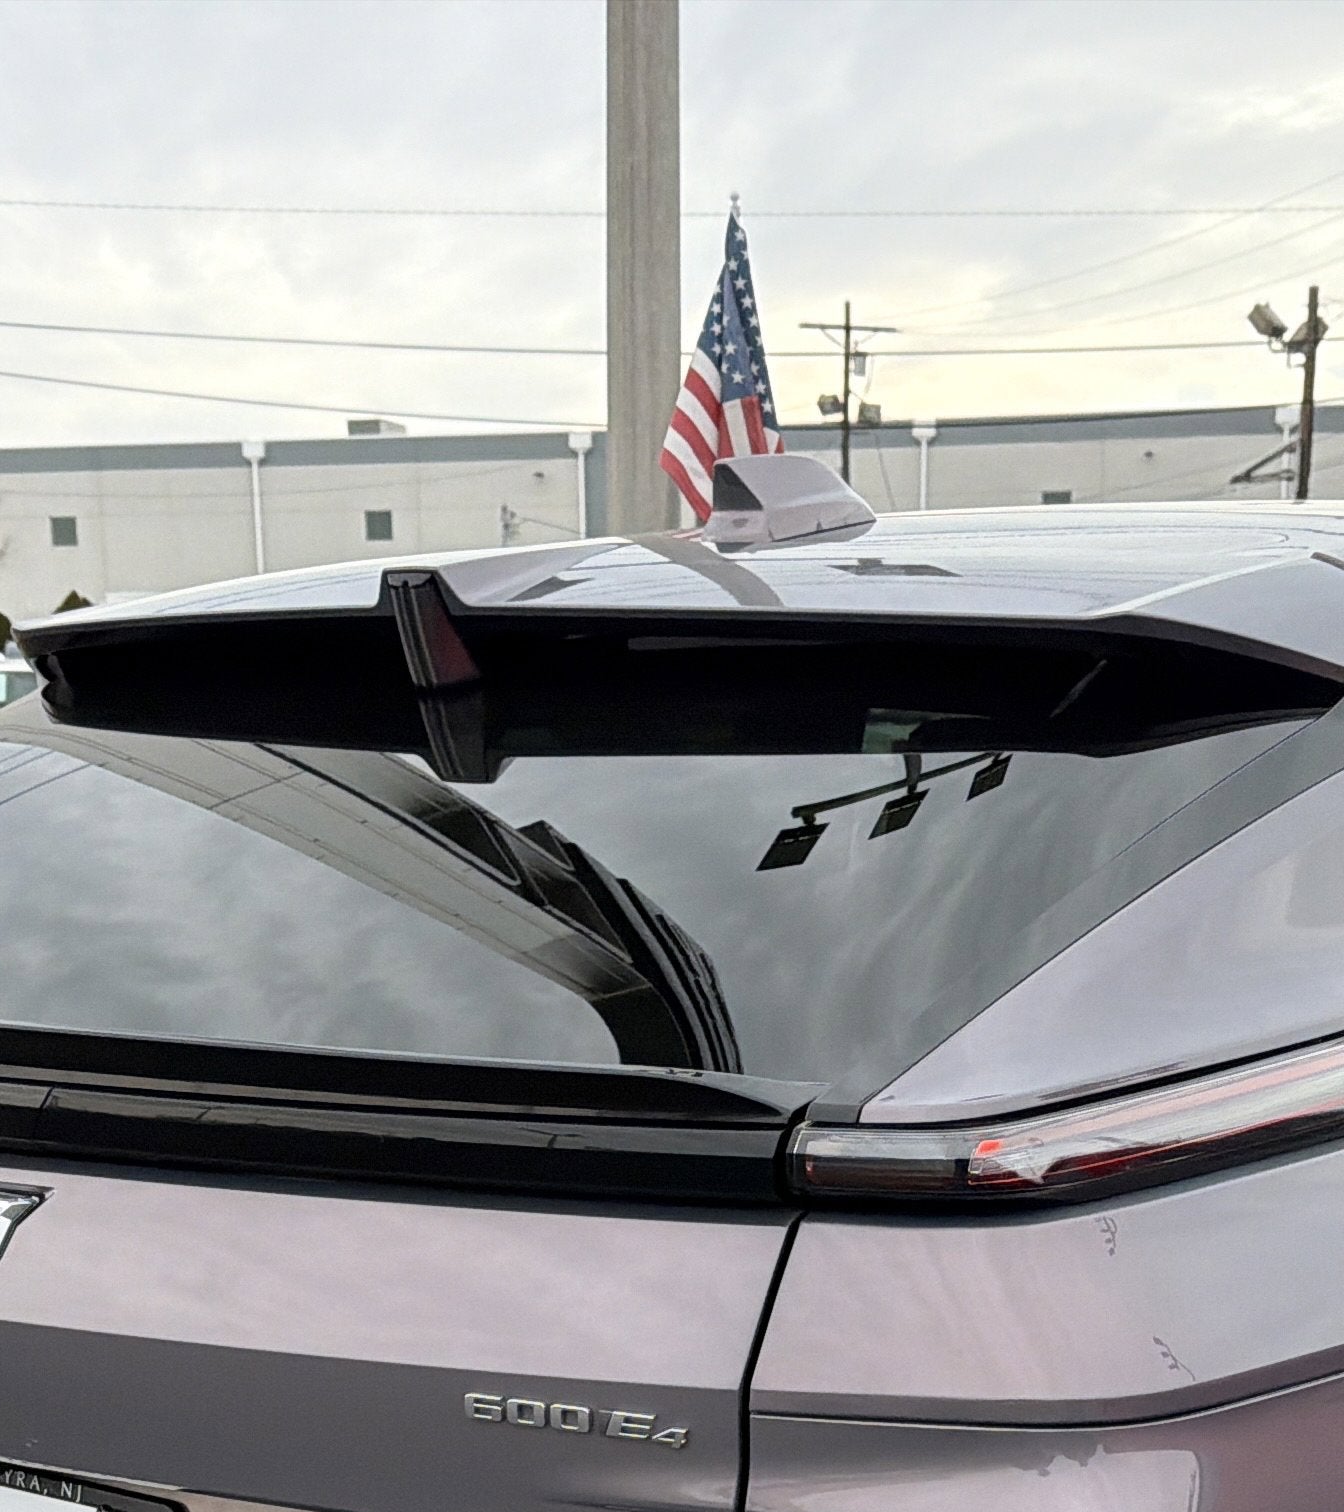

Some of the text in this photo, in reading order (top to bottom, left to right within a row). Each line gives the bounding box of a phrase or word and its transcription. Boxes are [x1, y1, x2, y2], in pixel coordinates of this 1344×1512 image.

[463, 1391, 689, 1450] 600 E4
[60, 1480, 82, 1503] NJ
